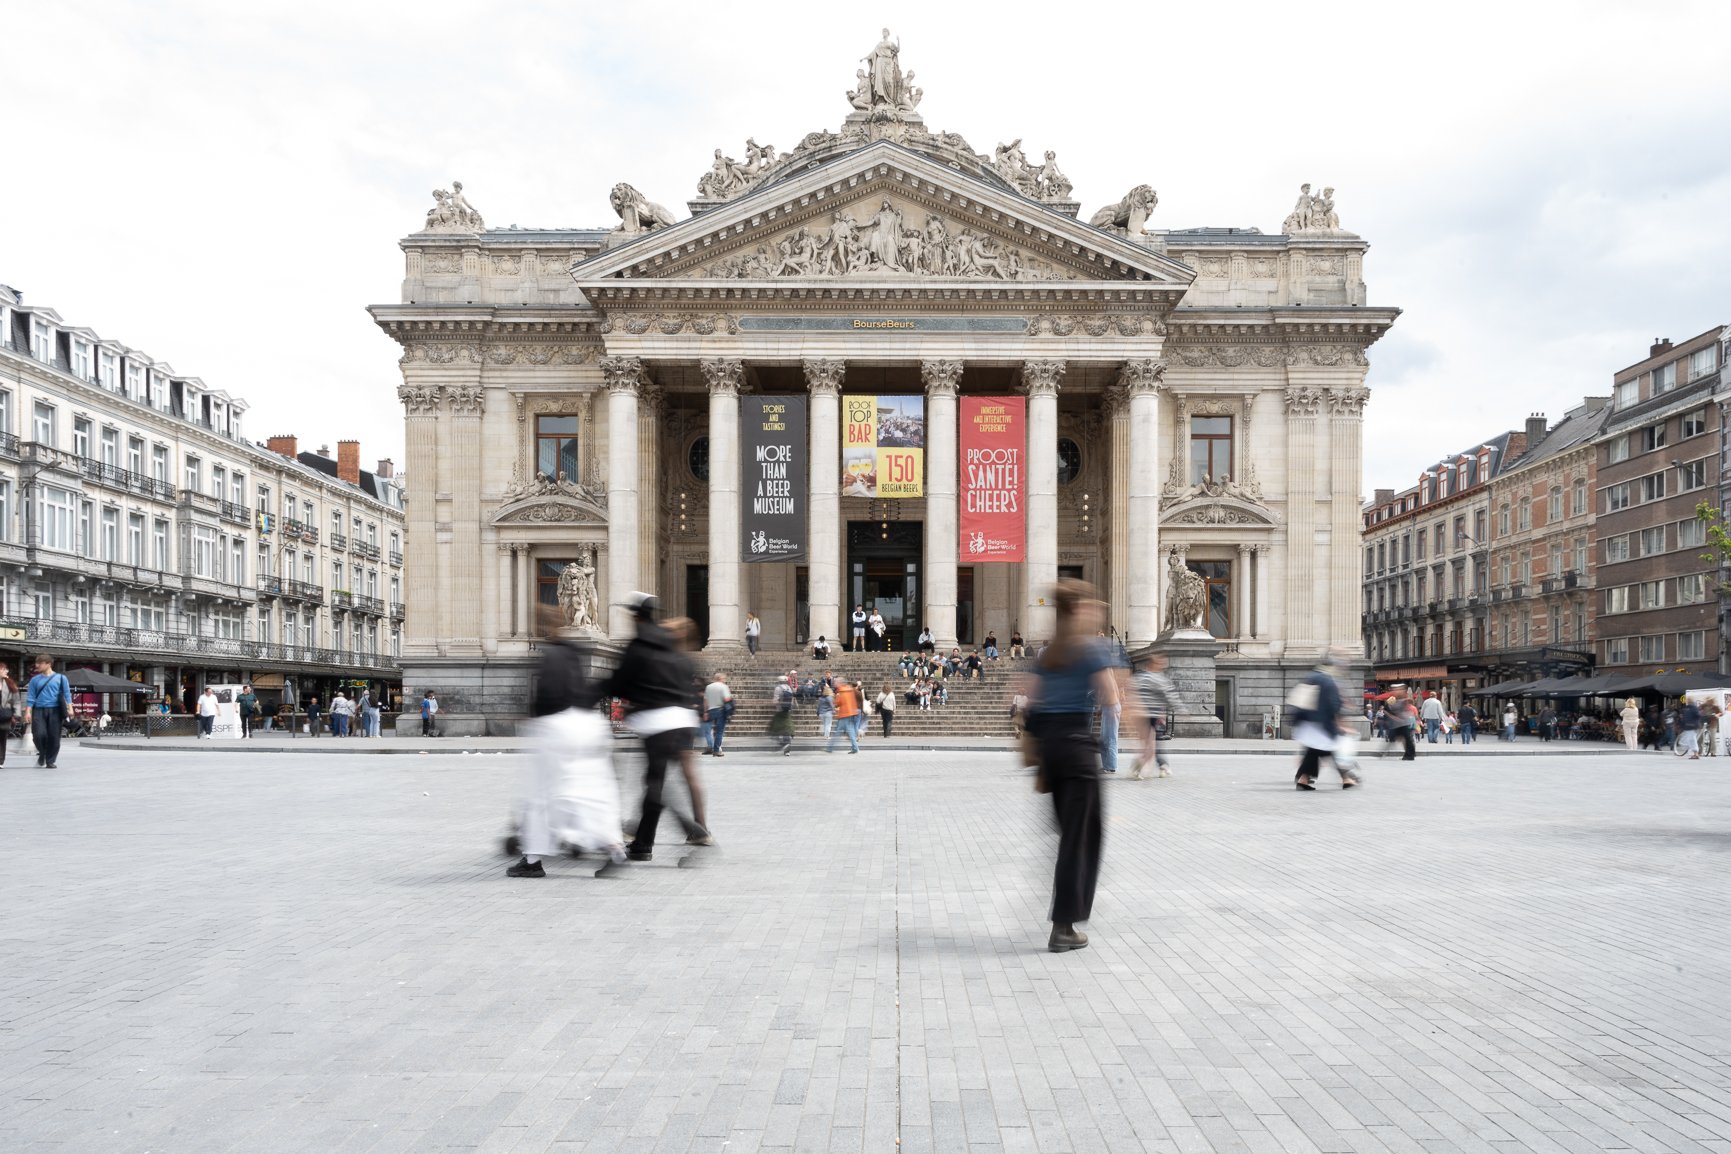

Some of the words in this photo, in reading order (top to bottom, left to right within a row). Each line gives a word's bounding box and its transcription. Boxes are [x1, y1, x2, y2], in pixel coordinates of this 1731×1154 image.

[853, 319, 915, 328] BourseBeurs
[762, 404, 786, 413] STORIES
[848, 401, 871, 410] ROOF
[769, 413, 779, 421] AND
[849, 410, 872, 422] TOP
[848, 423, 872, 443] BAR
[979, 424, 1007, 432] EXPERIENCE
[756, 445, 792, 461] MORE
[967, 448, 1019, 464] PROOST
[761, 462, 787, 479] THAN
[885, 454, 915, 483] 150
[967, 463, 1018, 489] SANTÉ!
[757, 480, 764, 497] A
[766, 480, 791, 497] BEER
[903, 484, 918, 492] BEERS
[753, 497, 794, 514] MUSEUM
[967, 490, 1018, 513] CHEERS
